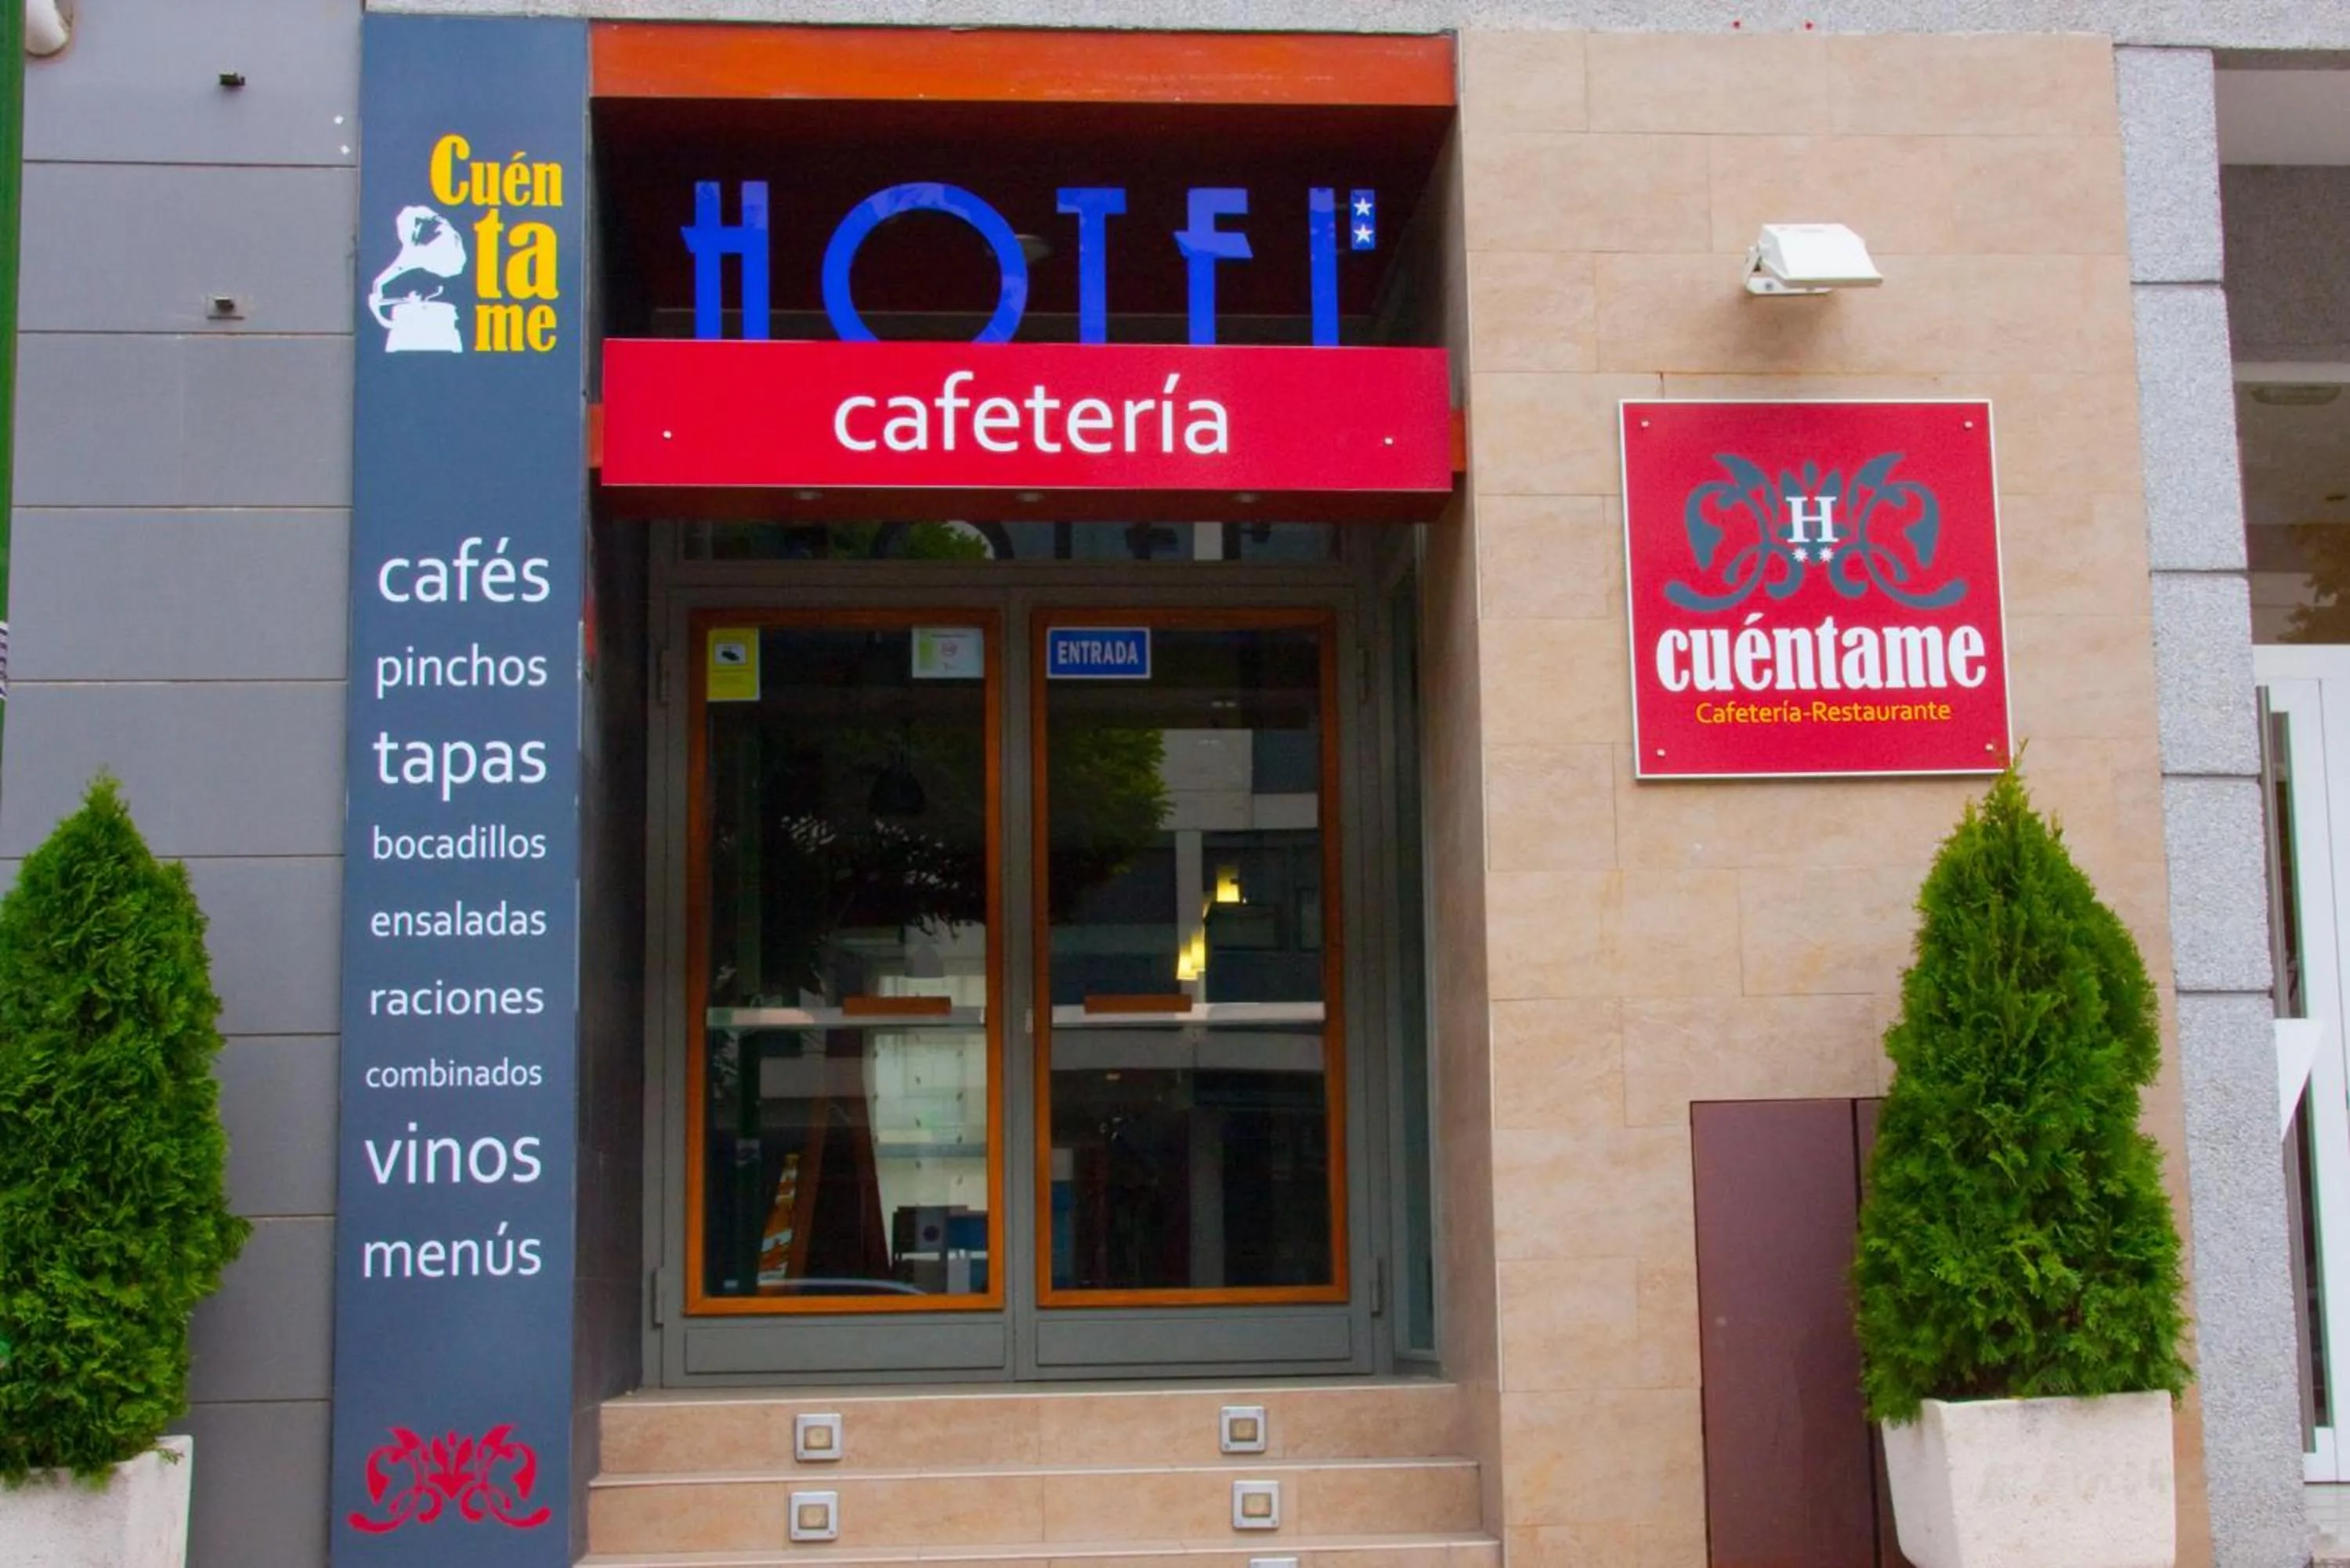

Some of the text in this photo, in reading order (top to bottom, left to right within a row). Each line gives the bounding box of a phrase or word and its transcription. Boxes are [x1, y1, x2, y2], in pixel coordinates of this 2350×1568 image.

[430, 134, 562, 207] Cuén
[474, 208, 559, 299] ta
[474, 305, 558, 352] me
[833, 370, 1230, 453] cafetería
[1785, 496, 1838, 544] H
[378, 537, 550, 602] cafés
[376, 643, 548, 699] pinchos
[1056, 639, 1139, 666] ENTRADA
[1656, 612, 1987, 692] cuéntame
[1695, 700, 1952, 724] Cafetería-Restaurante
[372, 732, 547, 801] tapas
[373, 825, 546, 860] bocadillos
[371, 901, 547, 937] ensaladas
[369, 980, 545, 1016] raciones
[366, 1057, 542, 1088] combinados
[364, 1122, 541, 1185] vinos
[363, 1221, 541, 1277] menús
